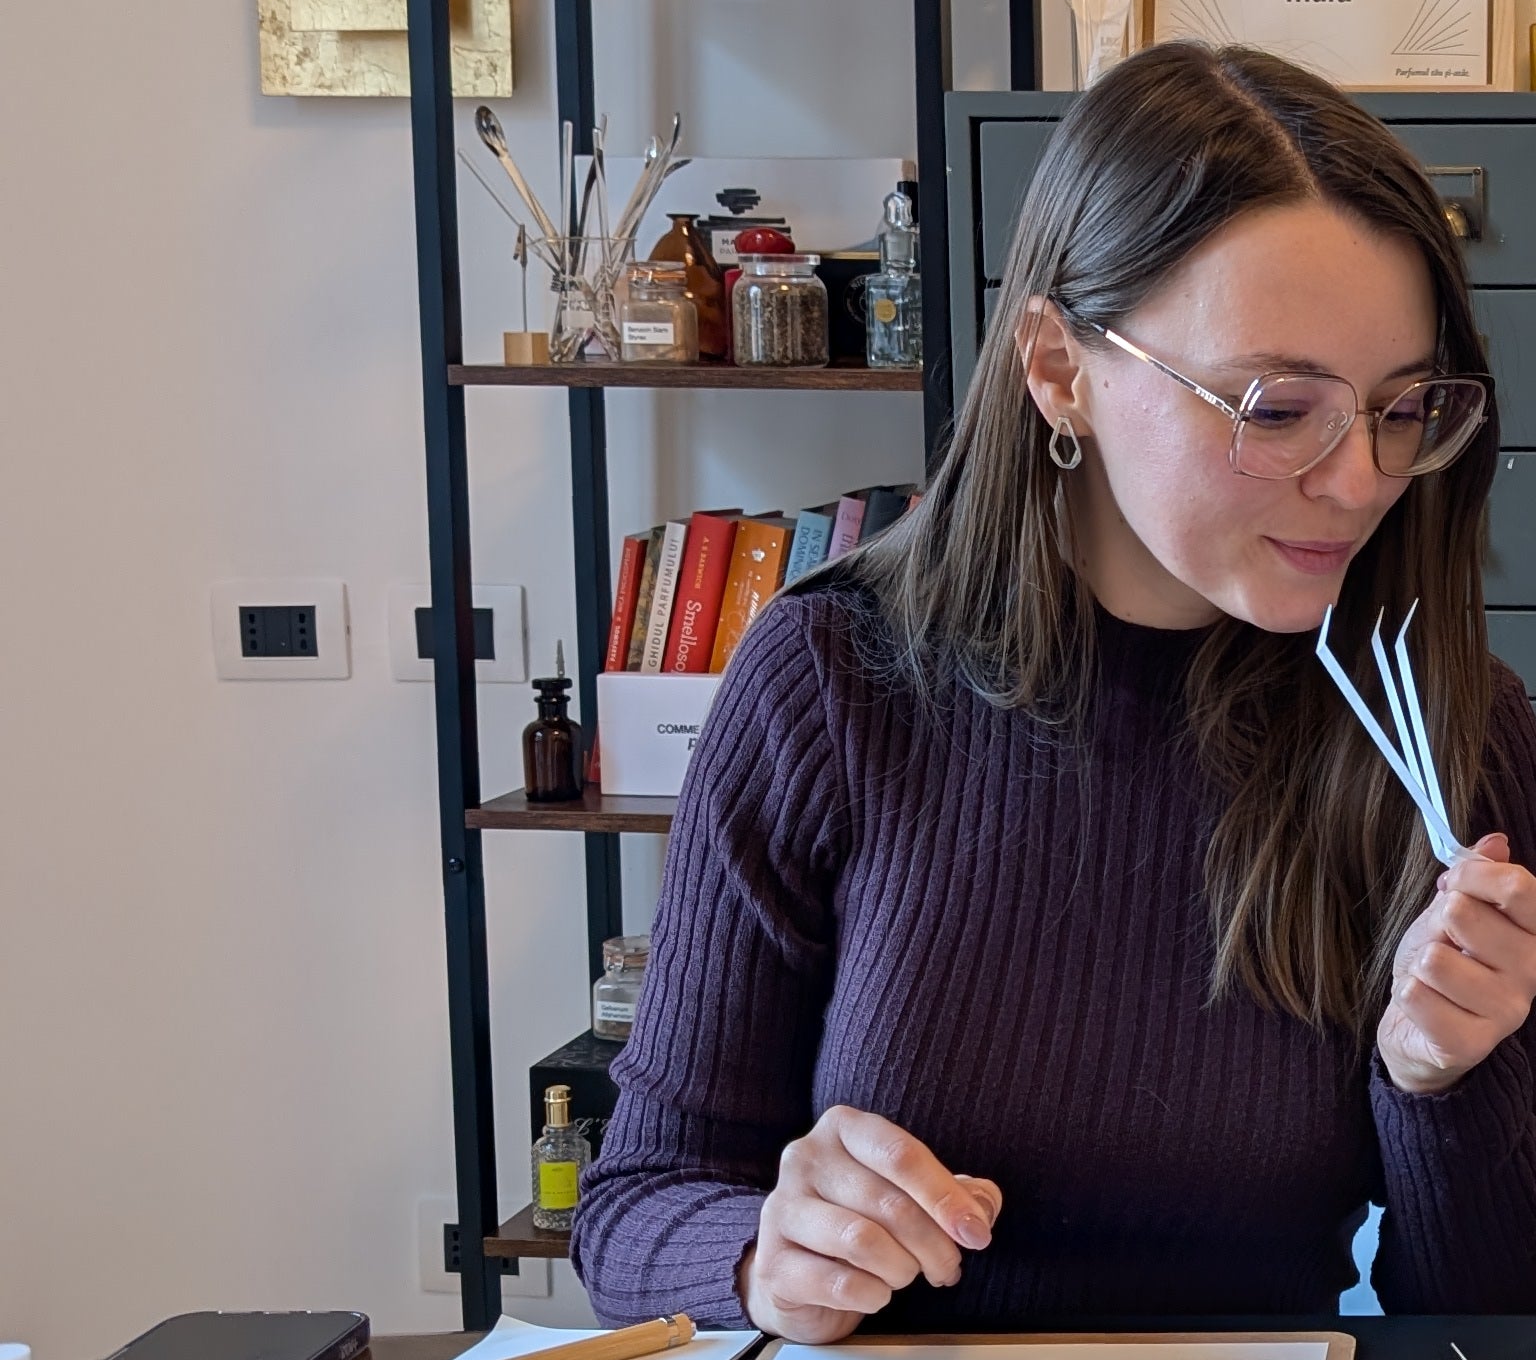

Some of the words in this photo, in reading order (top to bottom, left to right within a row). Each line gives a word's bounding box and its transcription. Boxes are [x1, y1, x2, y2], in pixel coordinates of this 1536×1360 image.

[647, 621, 664, 668] GHIDUL
[656, 537, 679, 617] PARFUMULUI
[677, 599, 702, 673] Smelloso
[657, 724, 699, 734] COMME
